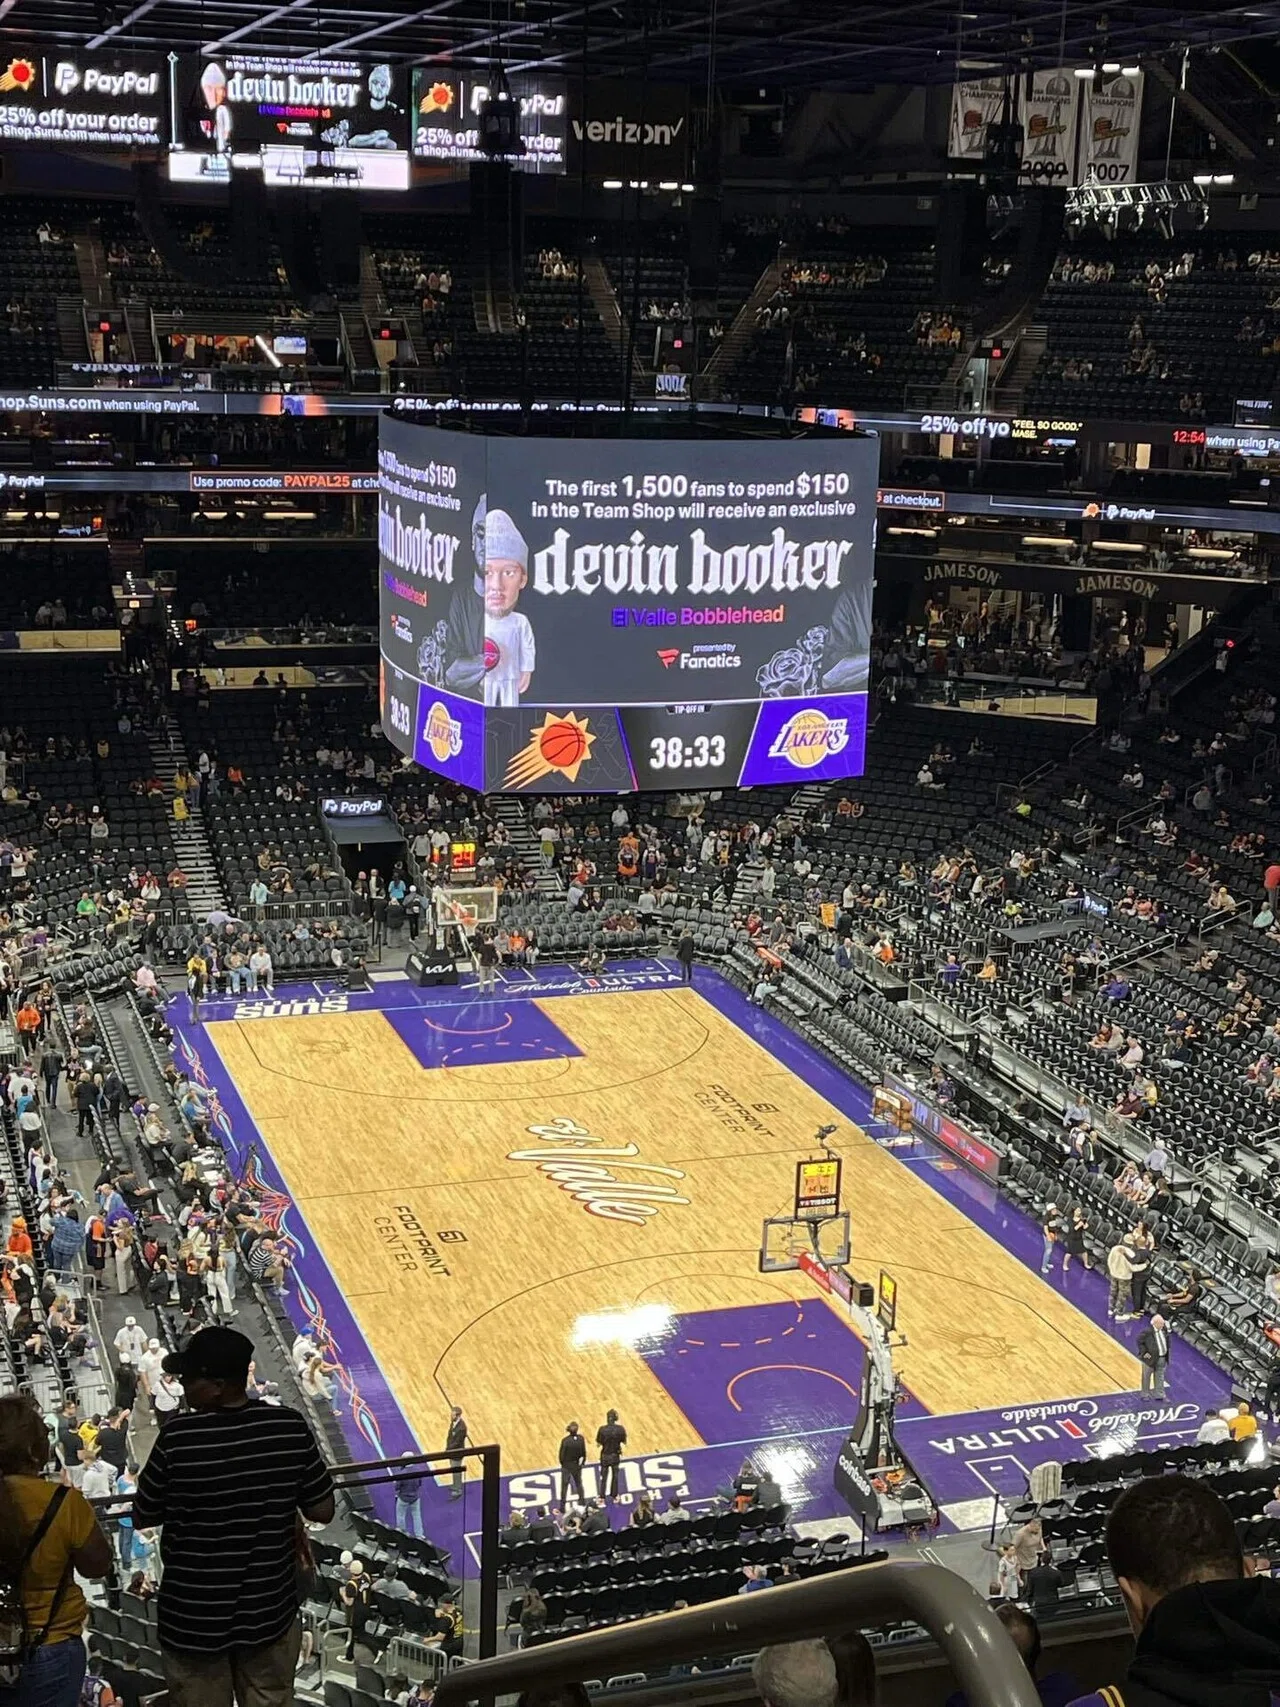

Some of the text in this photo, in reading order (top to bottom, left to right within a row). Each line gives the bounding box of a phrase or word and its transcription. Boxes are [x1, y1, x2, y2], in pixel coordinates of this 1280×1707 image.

[84, 69, 157, 95] PayPal
[227, 71, 360, 107] devin booker
[960, 90, 1007, 99] CHAMPION
[0, 105, 159, 131] 25% off your order
[3, 125, 87, 140] Shop.Suns.com
[417, 127, 452, 145] 25%
[455, 130, 479, 146] off
[572, 116, 684, 146] verizon
[1088, 163, 1130, 181] 2007
[103, 400, 131, 410] when
[134, 400, 161, 412] using
[163, 400, 199, 412] PayPal.
[921, 415, 959, 433] 25%
[961, 418, 986, 434] off
[1011, 428, 1038, 439] MASE.
[1037, 420, 1050, 430] SO
[1172, 429, 1205, 444] 12:54
[1206, 436, 1235, 448] when
[1237, 437, 1267, 450] using
[9, 475, 45, 488] PayPal
[193, 476, 213, 487] Use
[216, 478, 250, 489] promo
[252, 476, 282, 487] code:
[284, 475, 350, 487] PAYPAL25
[352, 477, 361, 488] at
[429, 460, 456, 488] $150
[545, 472, 850, 499] The first 1,500 fans to spend $150
[883, 495, 893, 504] at
[531, 500, 856, 522] in the Team Shop will receive an exclusive
[1120, 508, 1156, 521] PayPal
[396, 504, 460, 585] booker
[532, 526, 854, 596] devin booker
[924, 563, 1000, 586] JAMESON
[1076, 575, 1158, 599] JAMESON
[612, 604, 785, 627] El Valle Bobblehead
[693, 643, 736, 654] presented by
[679, 652, 742, 669] Fanatics
[674, 705, 697, 714] TIP-OFF
[774, 726, 846, 753] LAKERS
[650, 735, 726, 769] 38:33
[341, 799, 382, 814] PayPal
[602, 974, 683, 986] ULTRA
[694, 1092, 746, 1133] CENTER
[707, 1083, 776, 1138] FOOTPRINT
[373, 1216, 418, 1272] CENTER
[393, 1205, 452, 1277] FOOTPRINT
[1001, 1400, 1098, 1423] Courtside
[928, 1403, 1200, 1454] Michelob ULTRA
[838, 1453, 872, 1497] coinbase
